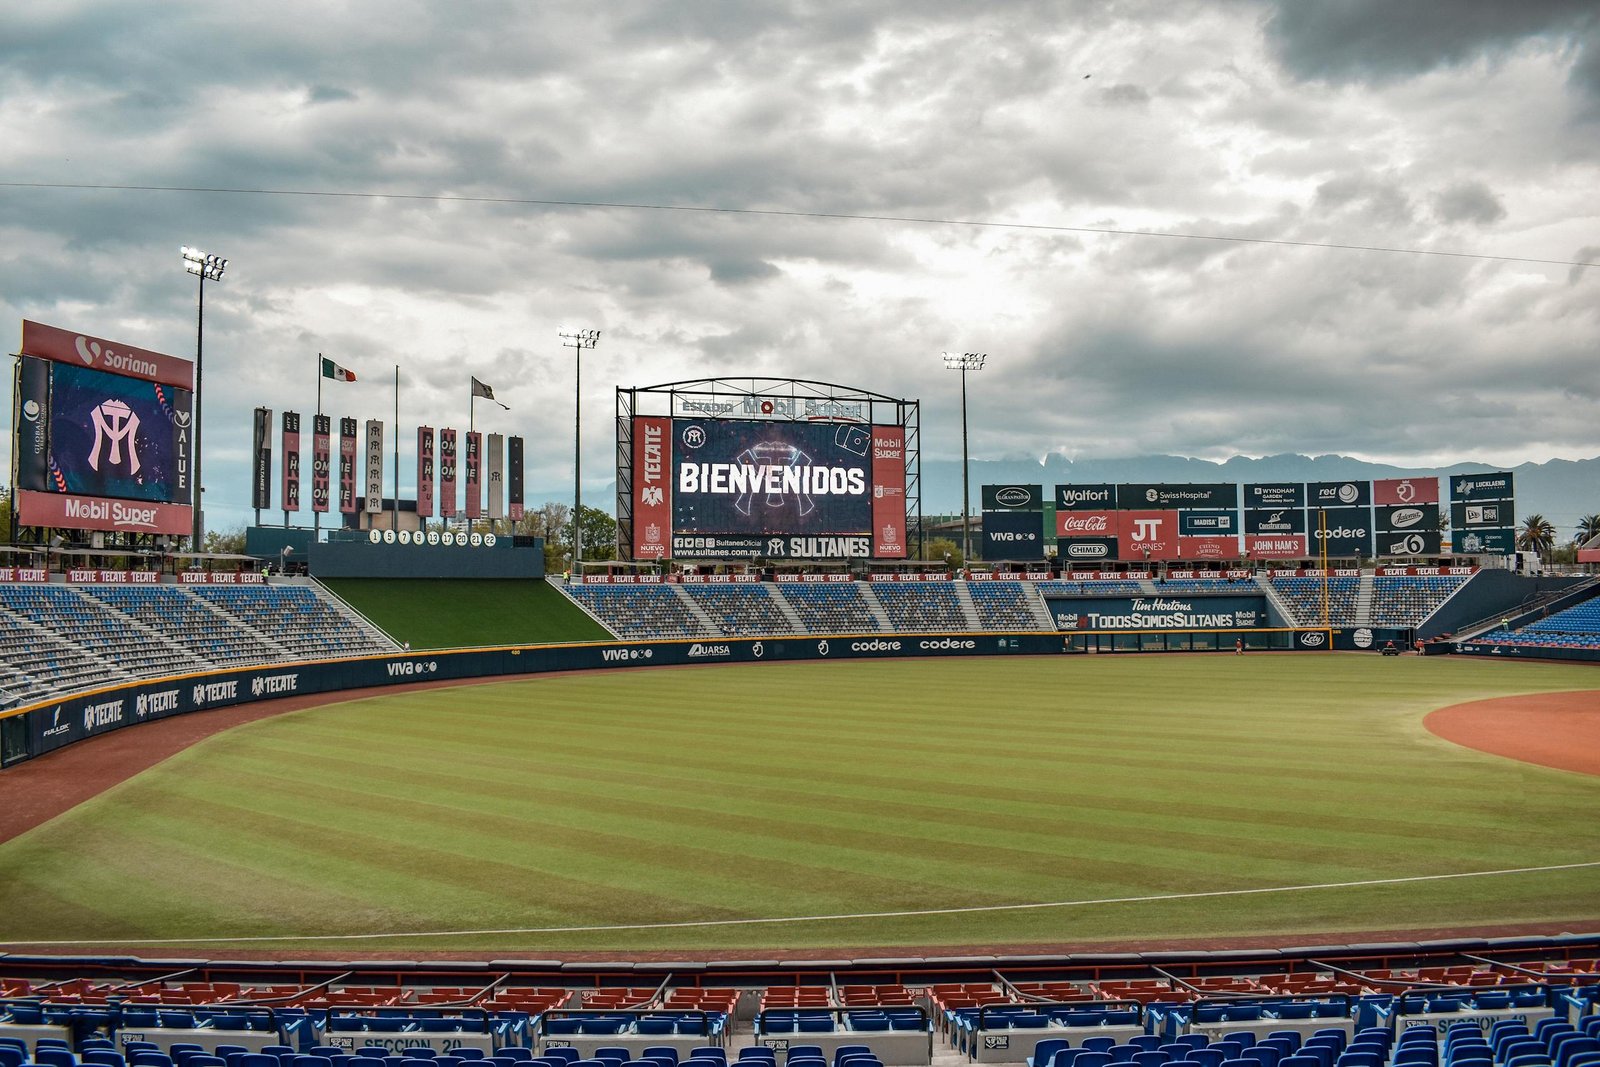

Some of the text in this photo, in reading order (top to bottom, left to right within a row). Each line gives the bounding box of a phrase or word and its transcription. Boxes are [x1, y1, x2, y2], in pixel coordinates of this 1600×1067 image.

[104, 349, 157, 376] Soriana
[682, 396, 861, 418] ESTADIO Mobil Super
[874, 438, 900, 447] Mobil
[174, 410, 191, 489] VALUE
[644, 422, 662, 483] TECATE
[874, 450, 900, 458] Super
[680, 462, 864, 494] BIENVENIDOS
[1062, 490, 1108, 500] Walfort
[66, 498, 157, 524] Mobil Super
[1064, 516, 1108, 531] Coca-Cola
[374, 532, 377, 540] 1
[388, 532, 392, 540] 5
[1132, 520, 1162, 541] JT
[1314, 526, 1366, 538] codere
[790, 537, 870, 558] SULTANES
[1130, 543, 1162, 551] CARNES
[1253, 540, 1298, 550] JOHN HAM'S
[1407, 534, 1420, 553] 6
[18, 569, 46, 581] TECATE
[70, 570, 97, 581] TECATE
[101, 571, 128, 582] TECATE
[131, 572, 158, 582] TECATE
[181, 572, 208, 582] TECATE
[211, 573, 237, 583] TECATE
[240, 573, 264, 583] TECATE
[1131, 598, 1192, 611] Tim Hortons
[851, 639, 901, 651] codere
[920, 638, 976, 649] codere
[264, 674, 298, 693] TECATE
[205, 680, 238, 701] TECATE
[148, 690, 180, 713] TECATE
[94, 700, 124, 726] TECATE
[442, 1039, 461, 1054] 20
